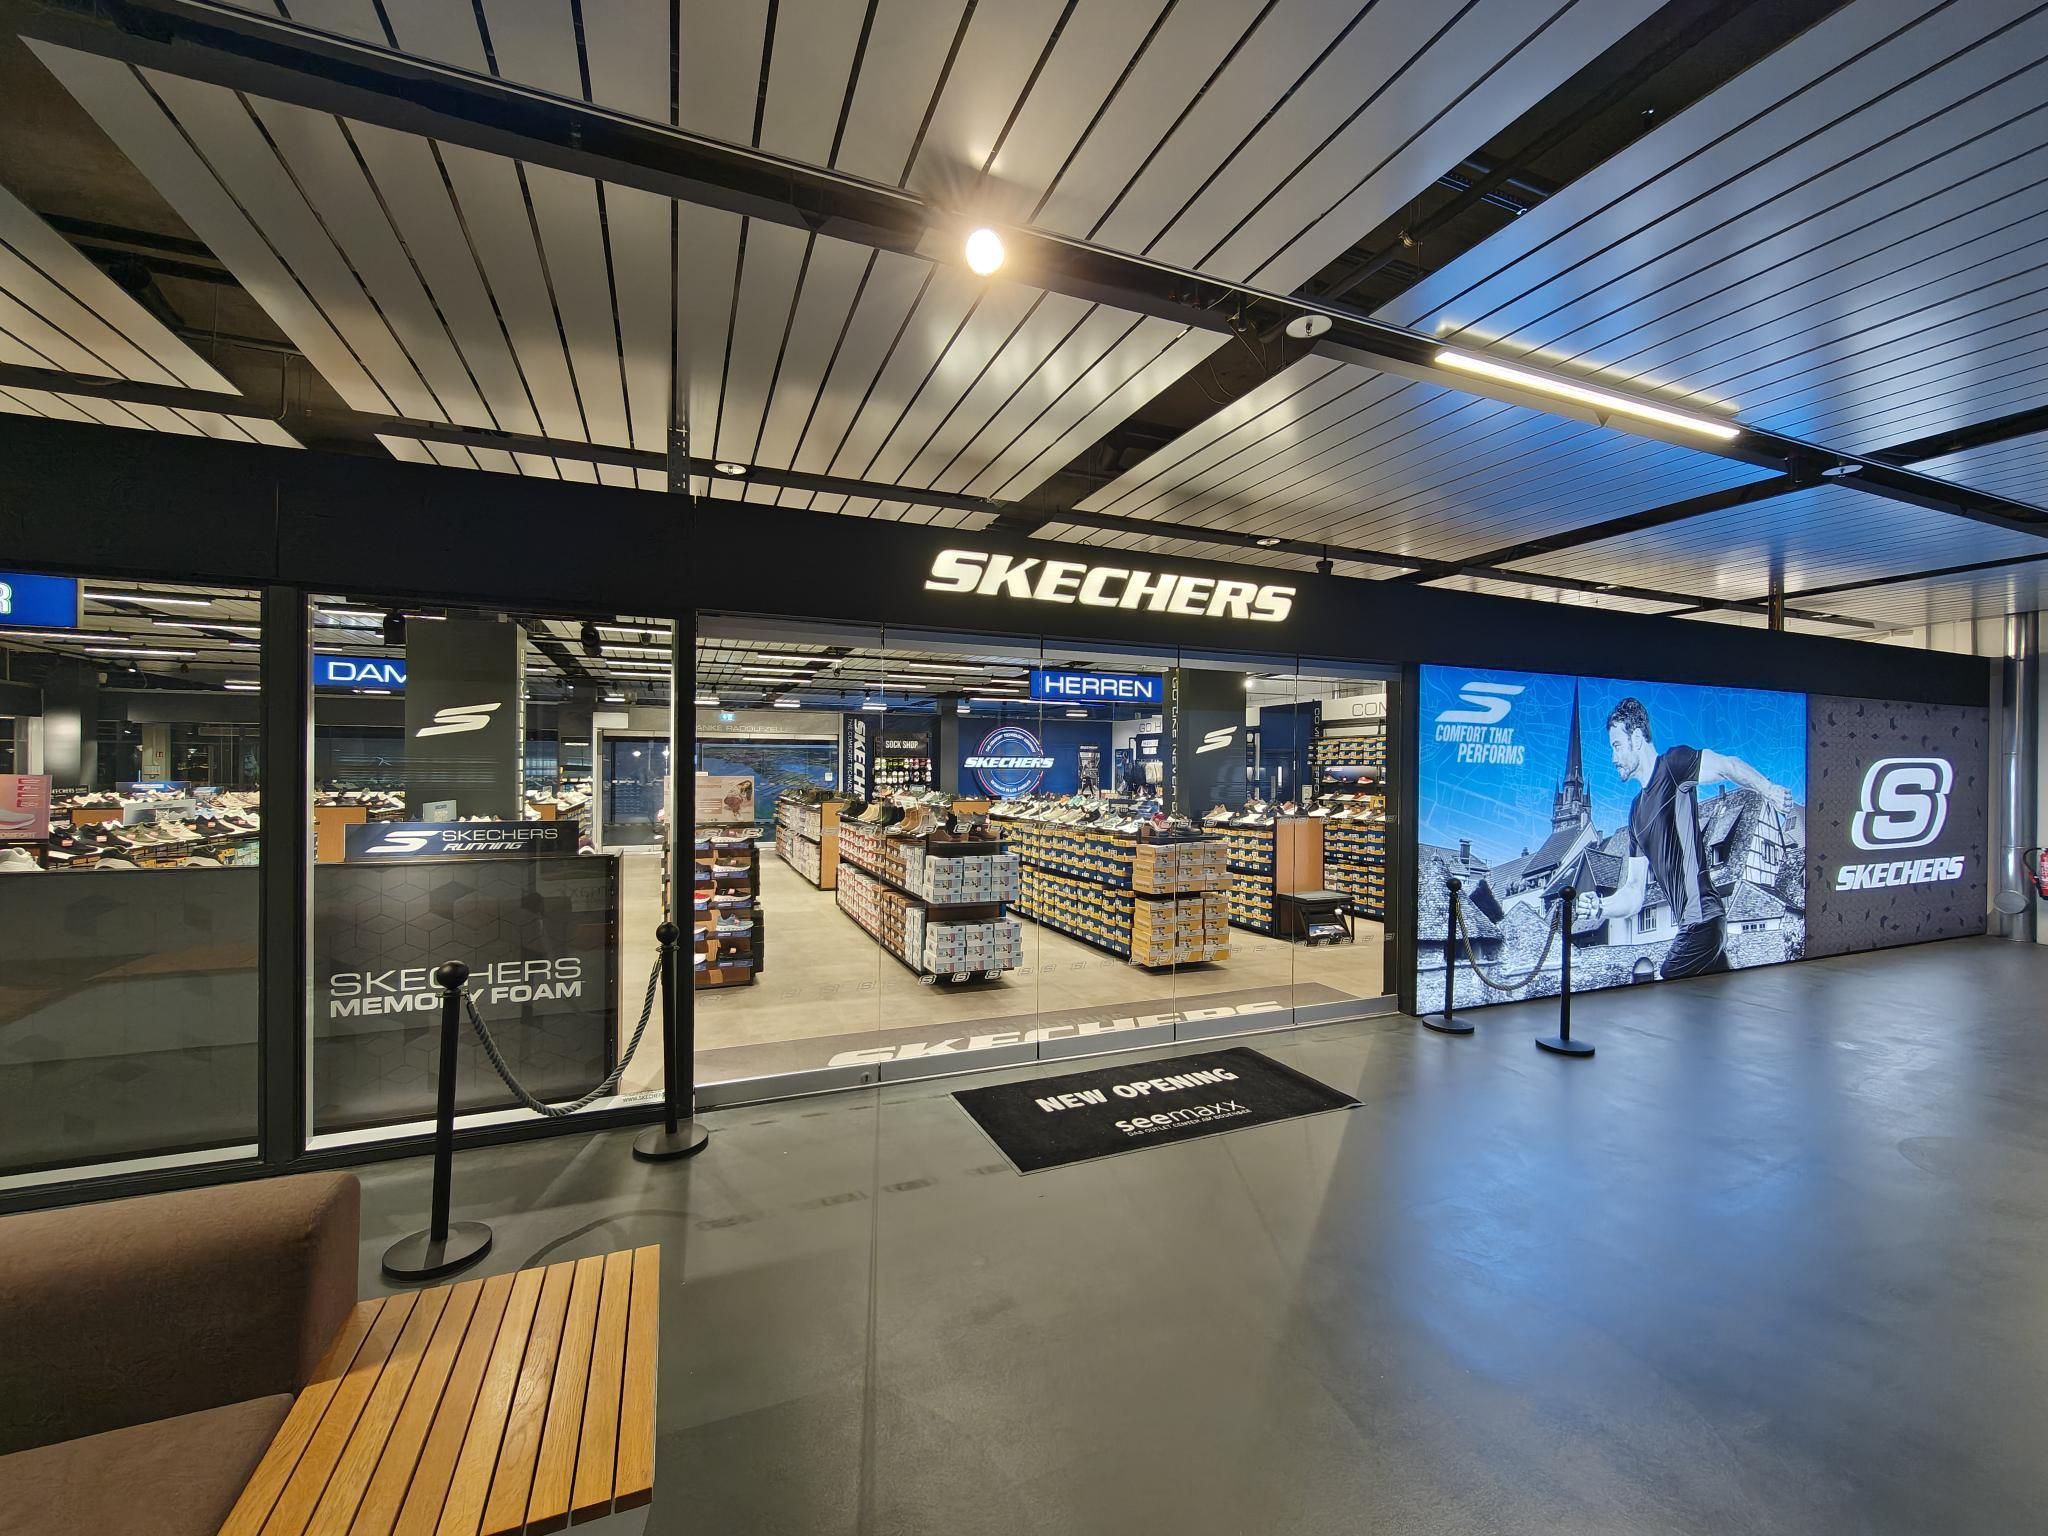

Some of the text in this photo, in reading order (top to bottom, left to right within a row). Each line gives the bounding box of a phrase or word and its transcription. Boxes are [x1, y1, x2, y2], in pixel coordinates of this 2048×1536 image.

[924, 548, 1297, 623] SKECHERS
[1045, 675, 1153, 698] HERREN
[885, 740, 919, 749] SOCK SHOP
[1435, 724, 1514, 744] COMFORT THAT
[963, 756, 1055, 769] SKECHERS
[1457, 743, 1526, 765] PERFORMS
[442, 828, 558, 840] SKECHERS
[442, 841, 528, 852] RUNNING
[1836, 856, 1965, 891] SKECHERS
[330, 981, 582, 1018] MEMOY FOAM
[1034, 1067, 1239, 1113] NEW OPENING
[1114, 1100, 1246, 1132] seemaxx
[1144, 1124, 1172, 1134] OUTLET
[1172, 1119, 1202, 1128] CENTER
